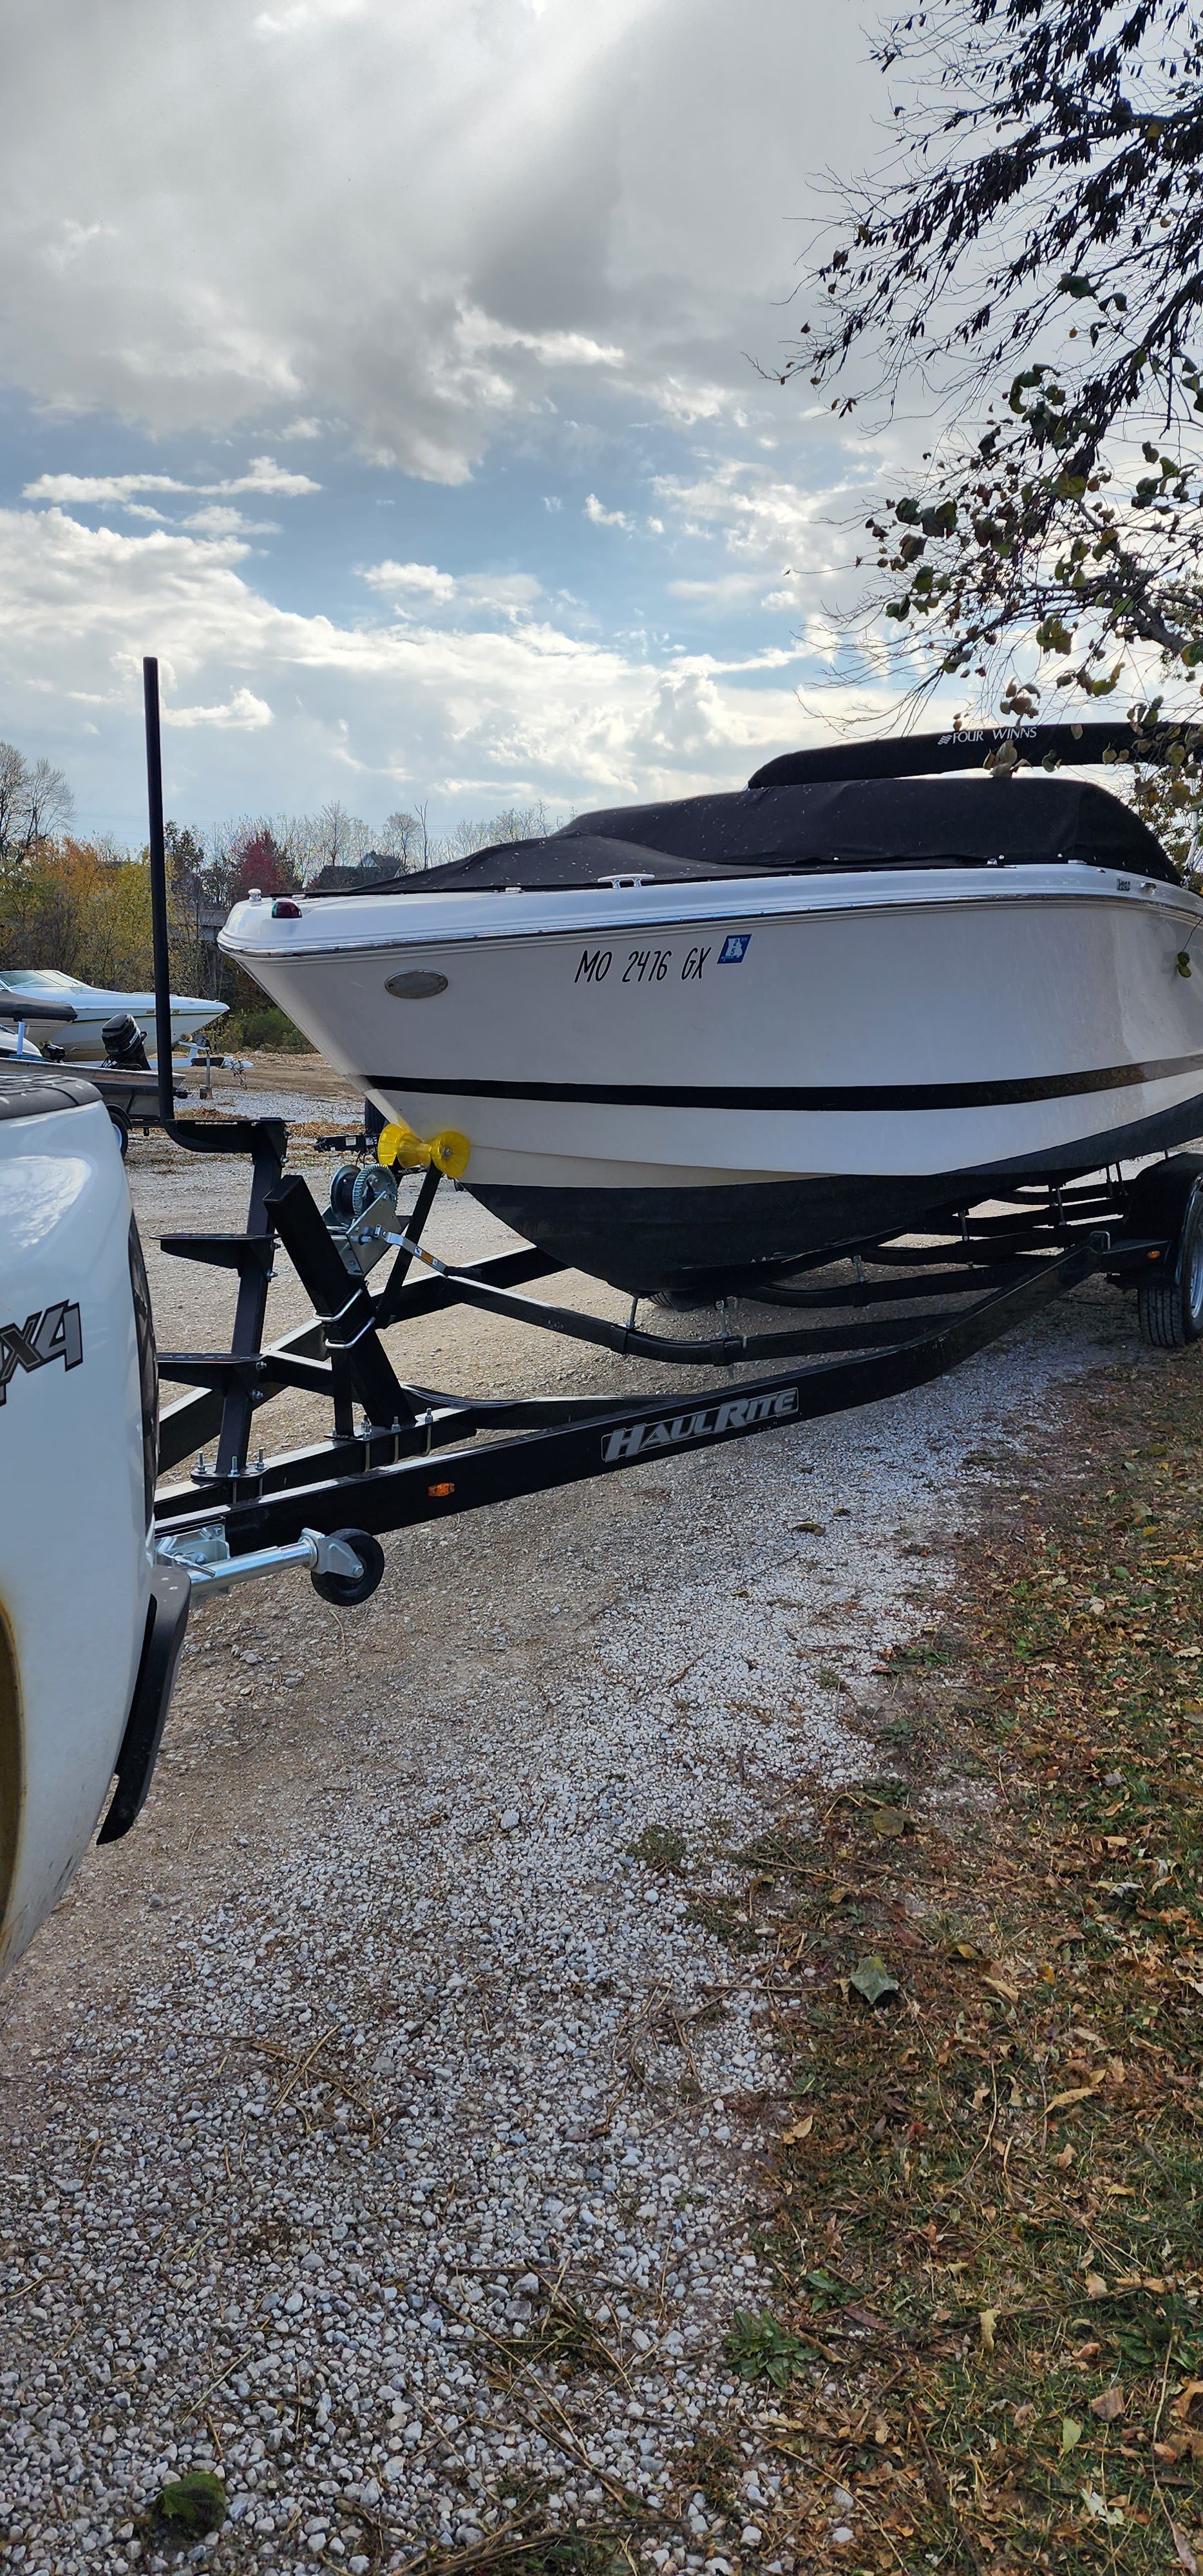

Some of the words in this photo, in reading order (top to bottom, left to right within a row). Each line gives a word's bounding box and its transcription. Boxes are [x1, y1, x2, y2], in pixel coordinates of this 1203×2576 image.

[952, 730, 984, 744] FOUR
[992, 726, 1037, 740] WINNS
[574, 950, 612, 983] MO
[621, 951, 672, 982] 2476
[681, 947, 712, 980] GX
